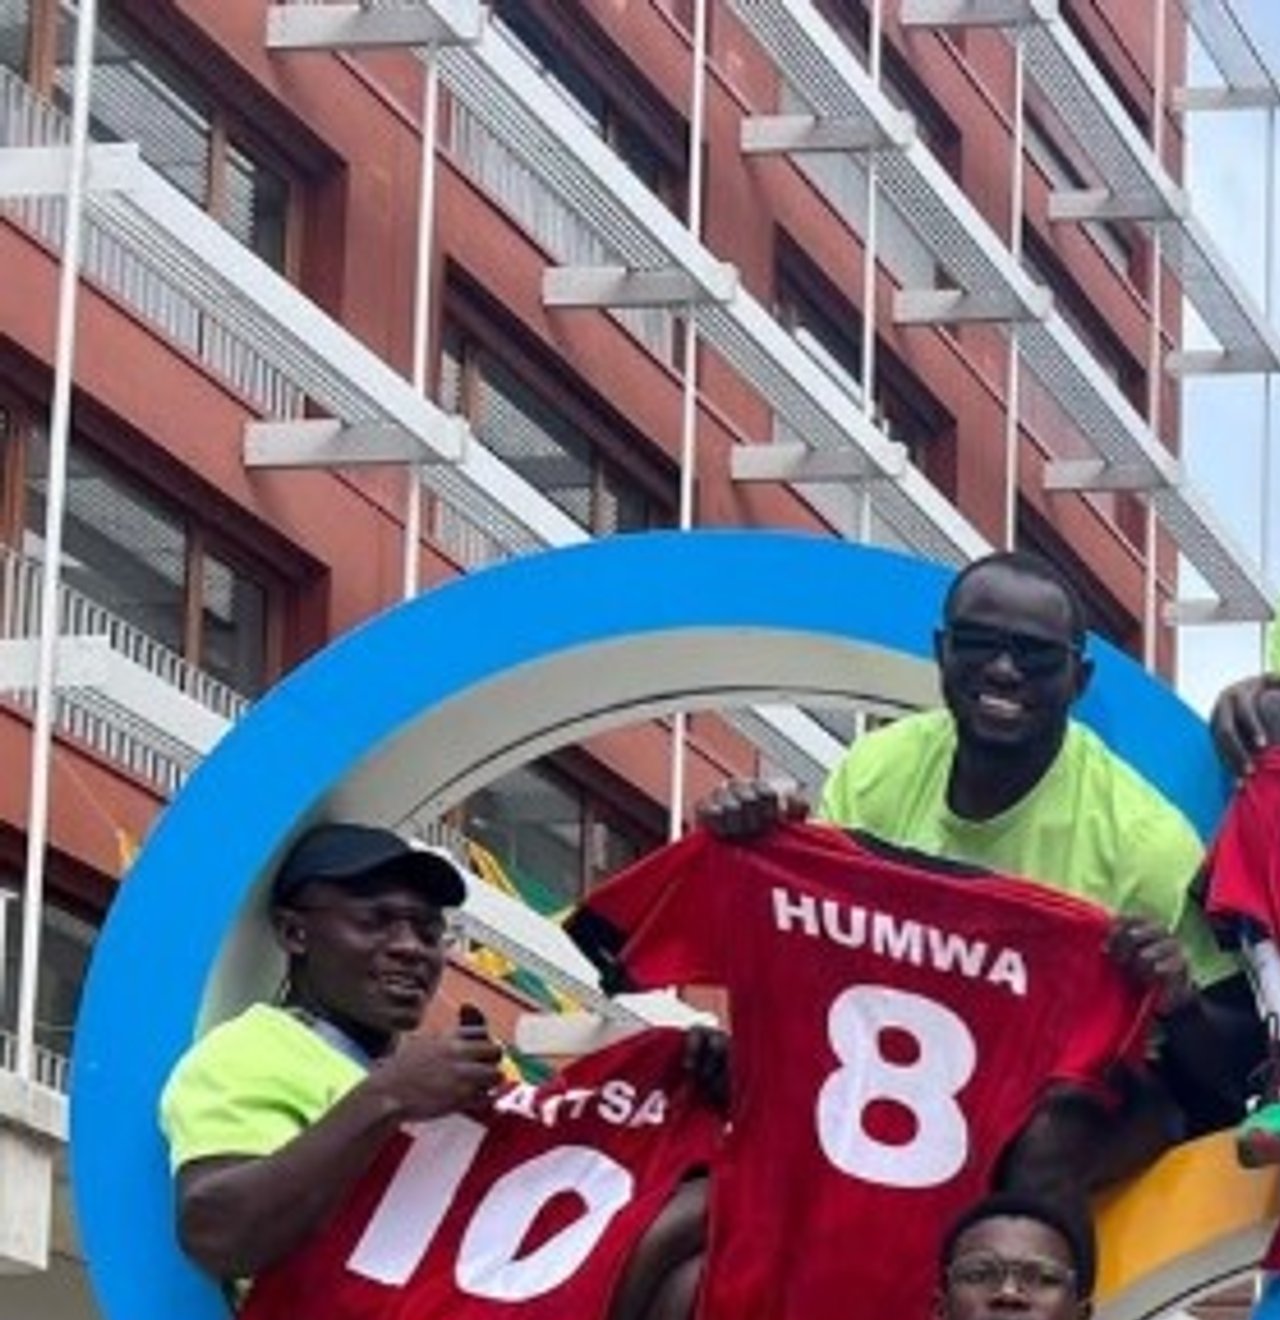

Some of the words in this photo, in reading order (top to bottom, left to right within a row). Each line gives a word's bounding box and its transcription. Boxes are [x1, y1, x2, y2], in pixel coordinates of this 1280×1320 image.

[771, 887, 1028, 995] HUMWA
[815, 984, 977, 1189] 8
[346, 1111, 635, 1303] 10
